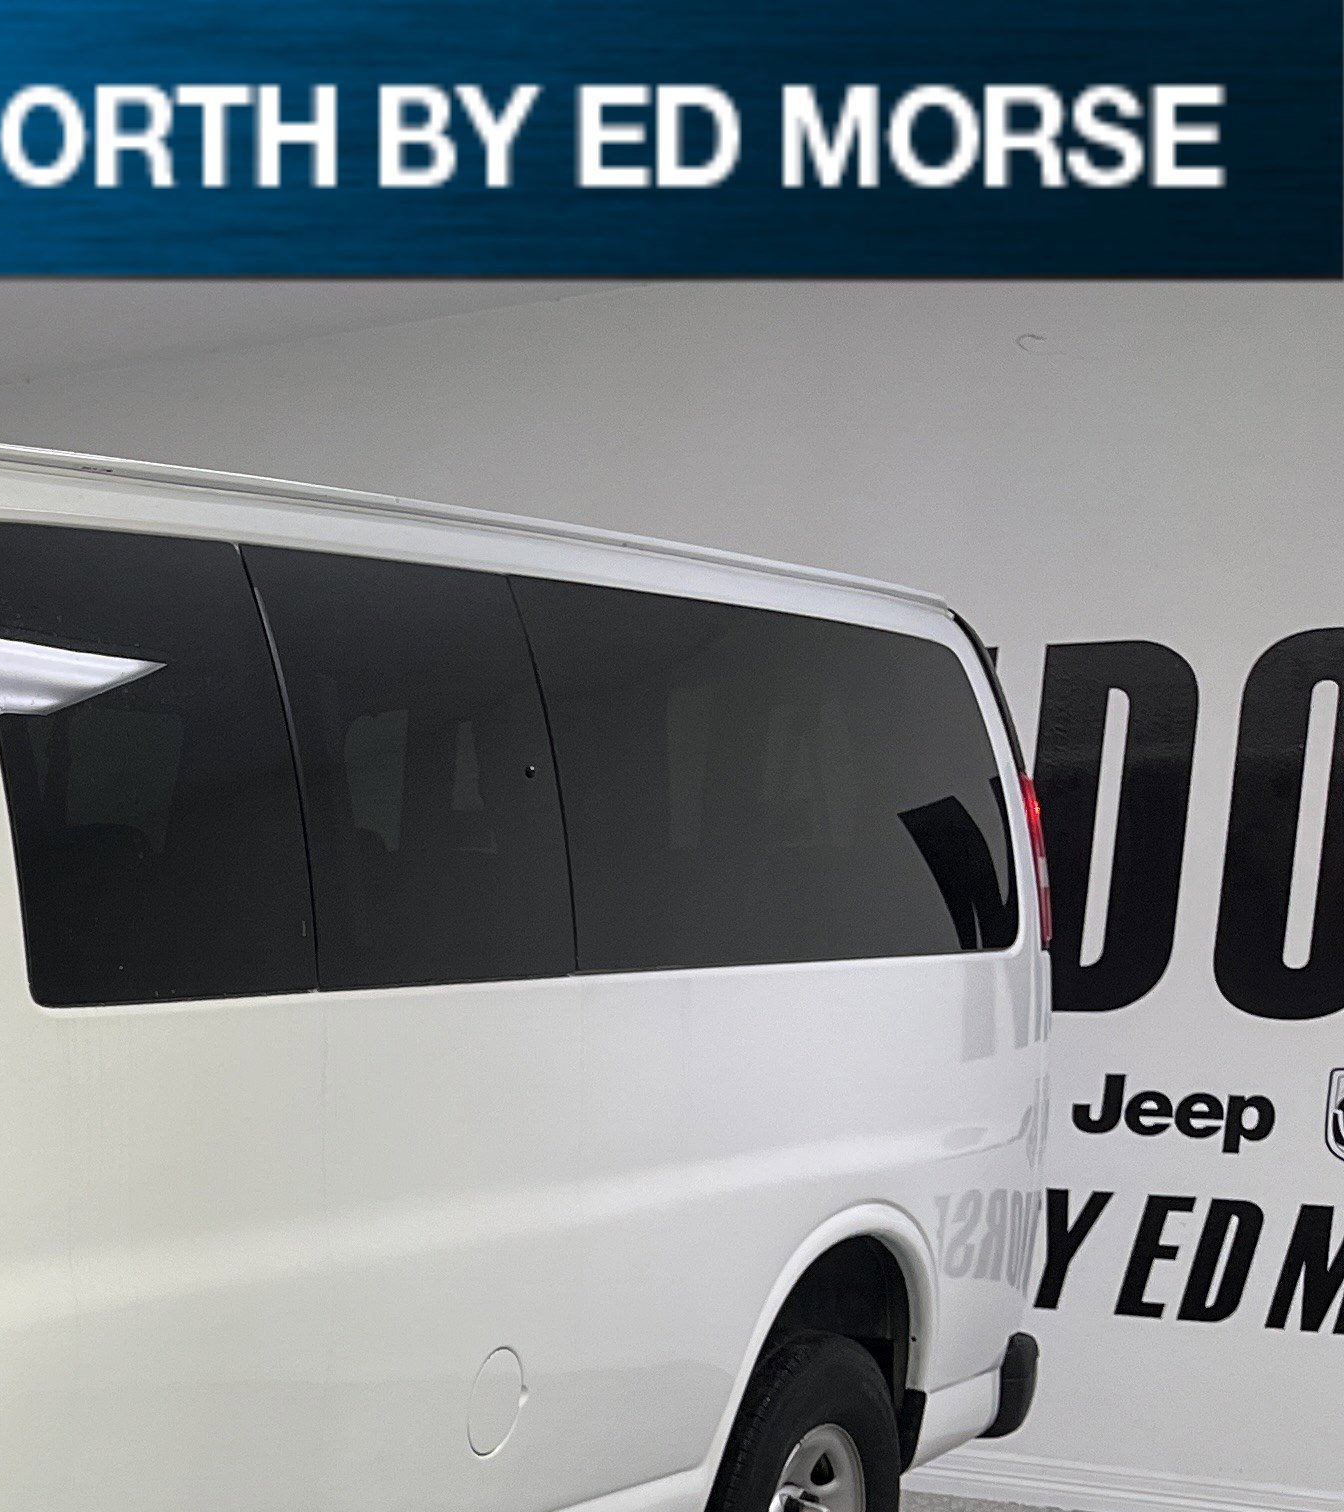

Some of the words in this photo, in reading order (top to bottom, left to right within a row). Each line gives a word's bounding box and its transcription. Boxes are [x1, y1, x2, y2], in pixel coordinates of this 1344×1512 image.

[985, 627, 1344, 1020] DO
[1070, 1073, 1276, 1155] Jeep
[1114, 1194, 1264, 1323] ED
